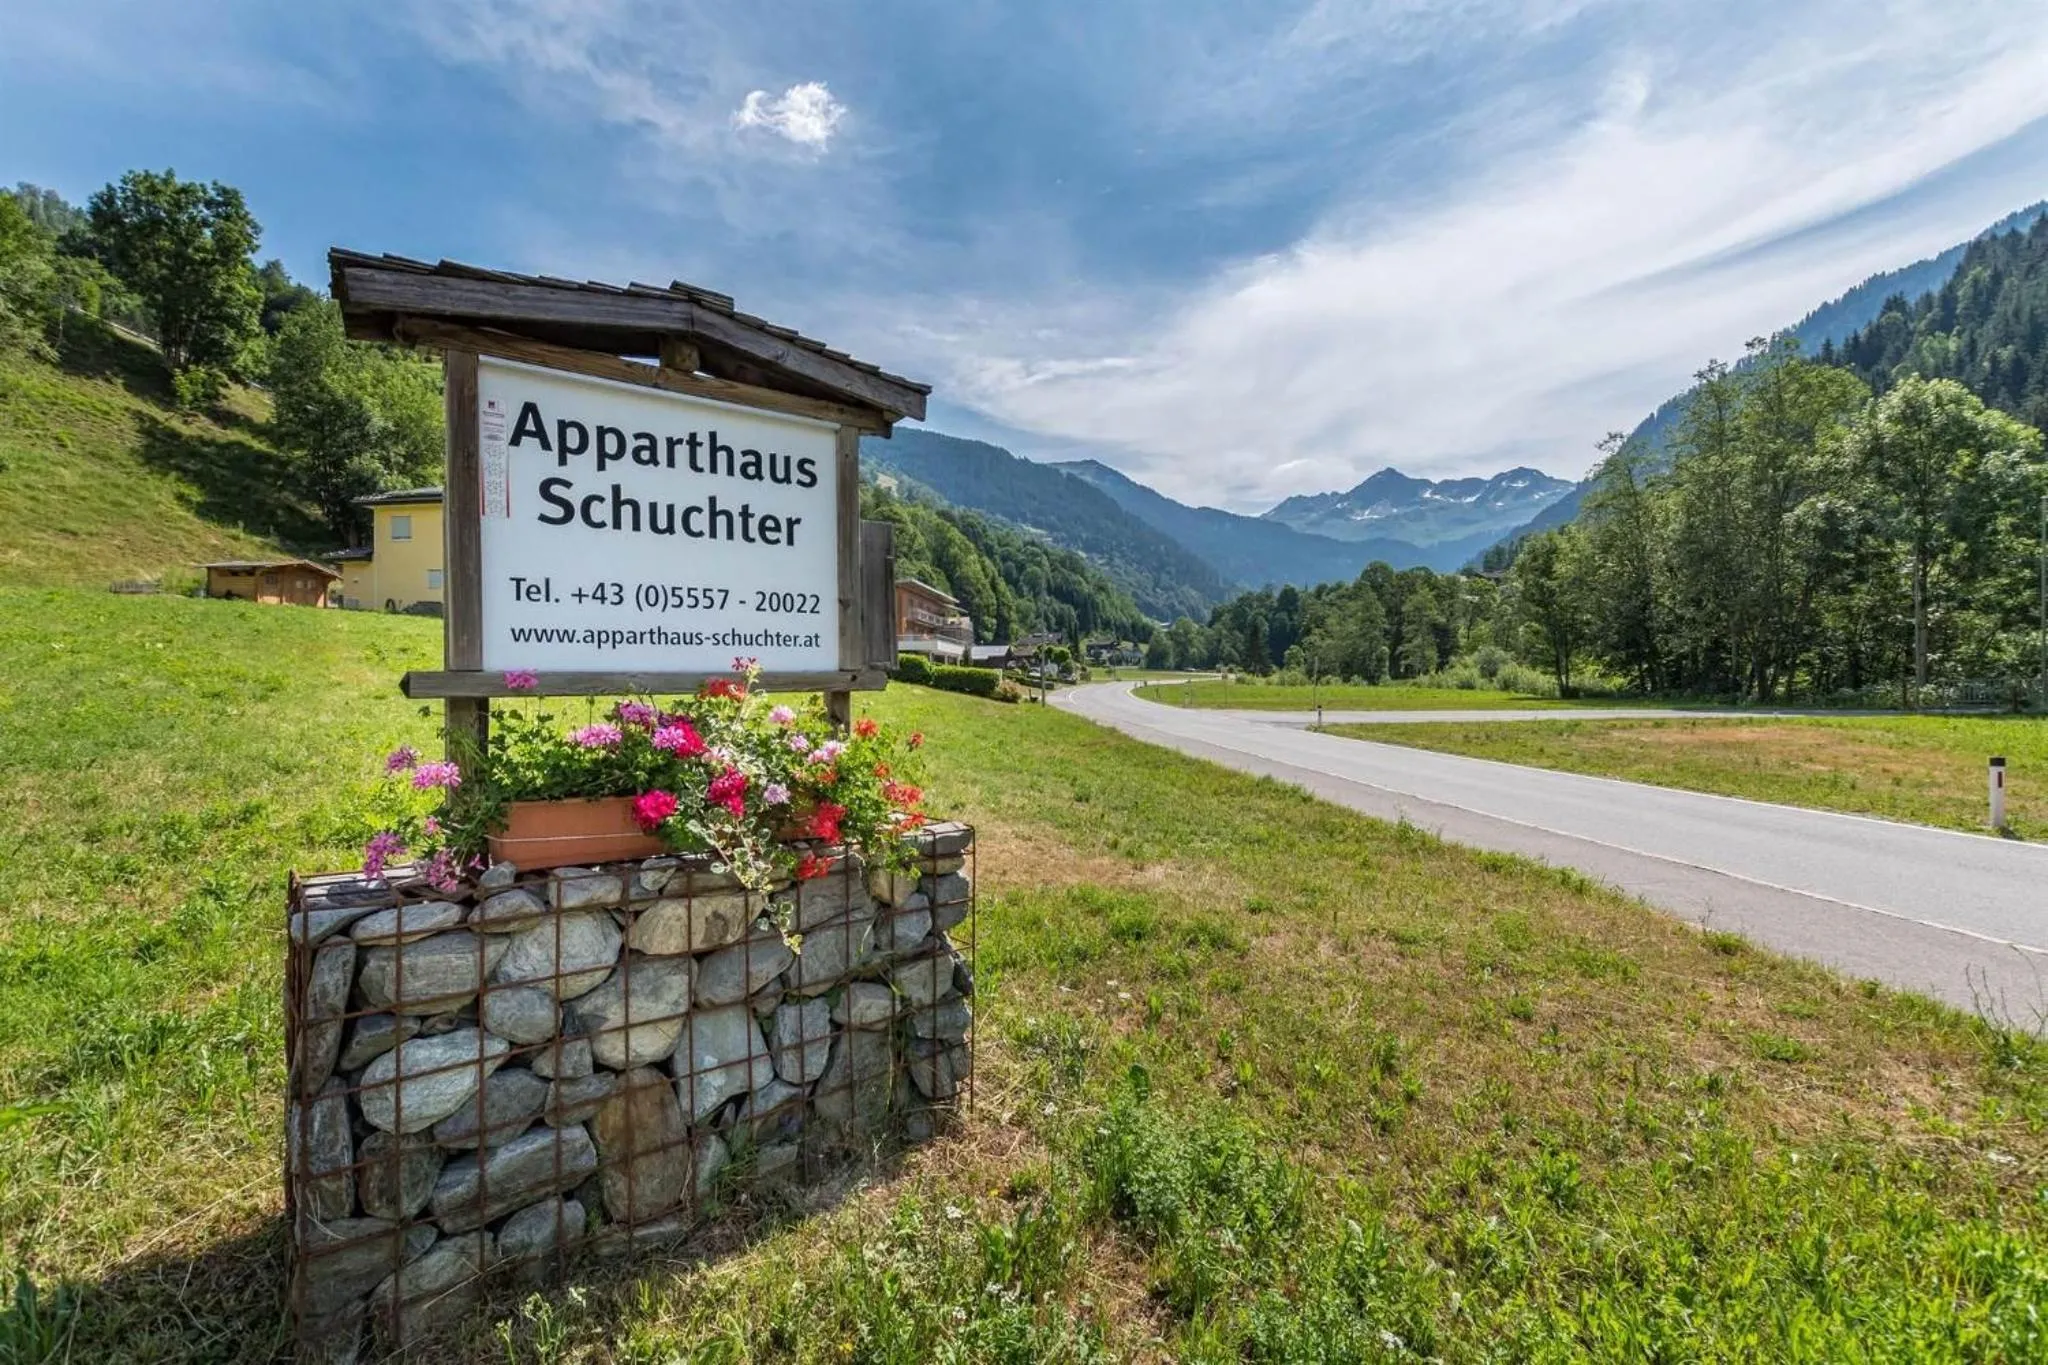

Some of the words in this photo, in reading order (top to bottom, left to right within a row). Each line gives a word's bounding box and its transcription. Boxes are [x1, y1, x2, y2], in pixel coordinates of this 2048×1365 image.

[508, 400, 819, 489] Apparthaus
[537, 476, 803, 547] Schuchter
[508, 576, 561, 604] Tel.
[570, 582, 625, 606] +43
[635, 583, 730, 613] (0)5557
[755, 590, 821, 615] 20022
[510, 625, 821, 650] www.apparthaus-schuchter.at
